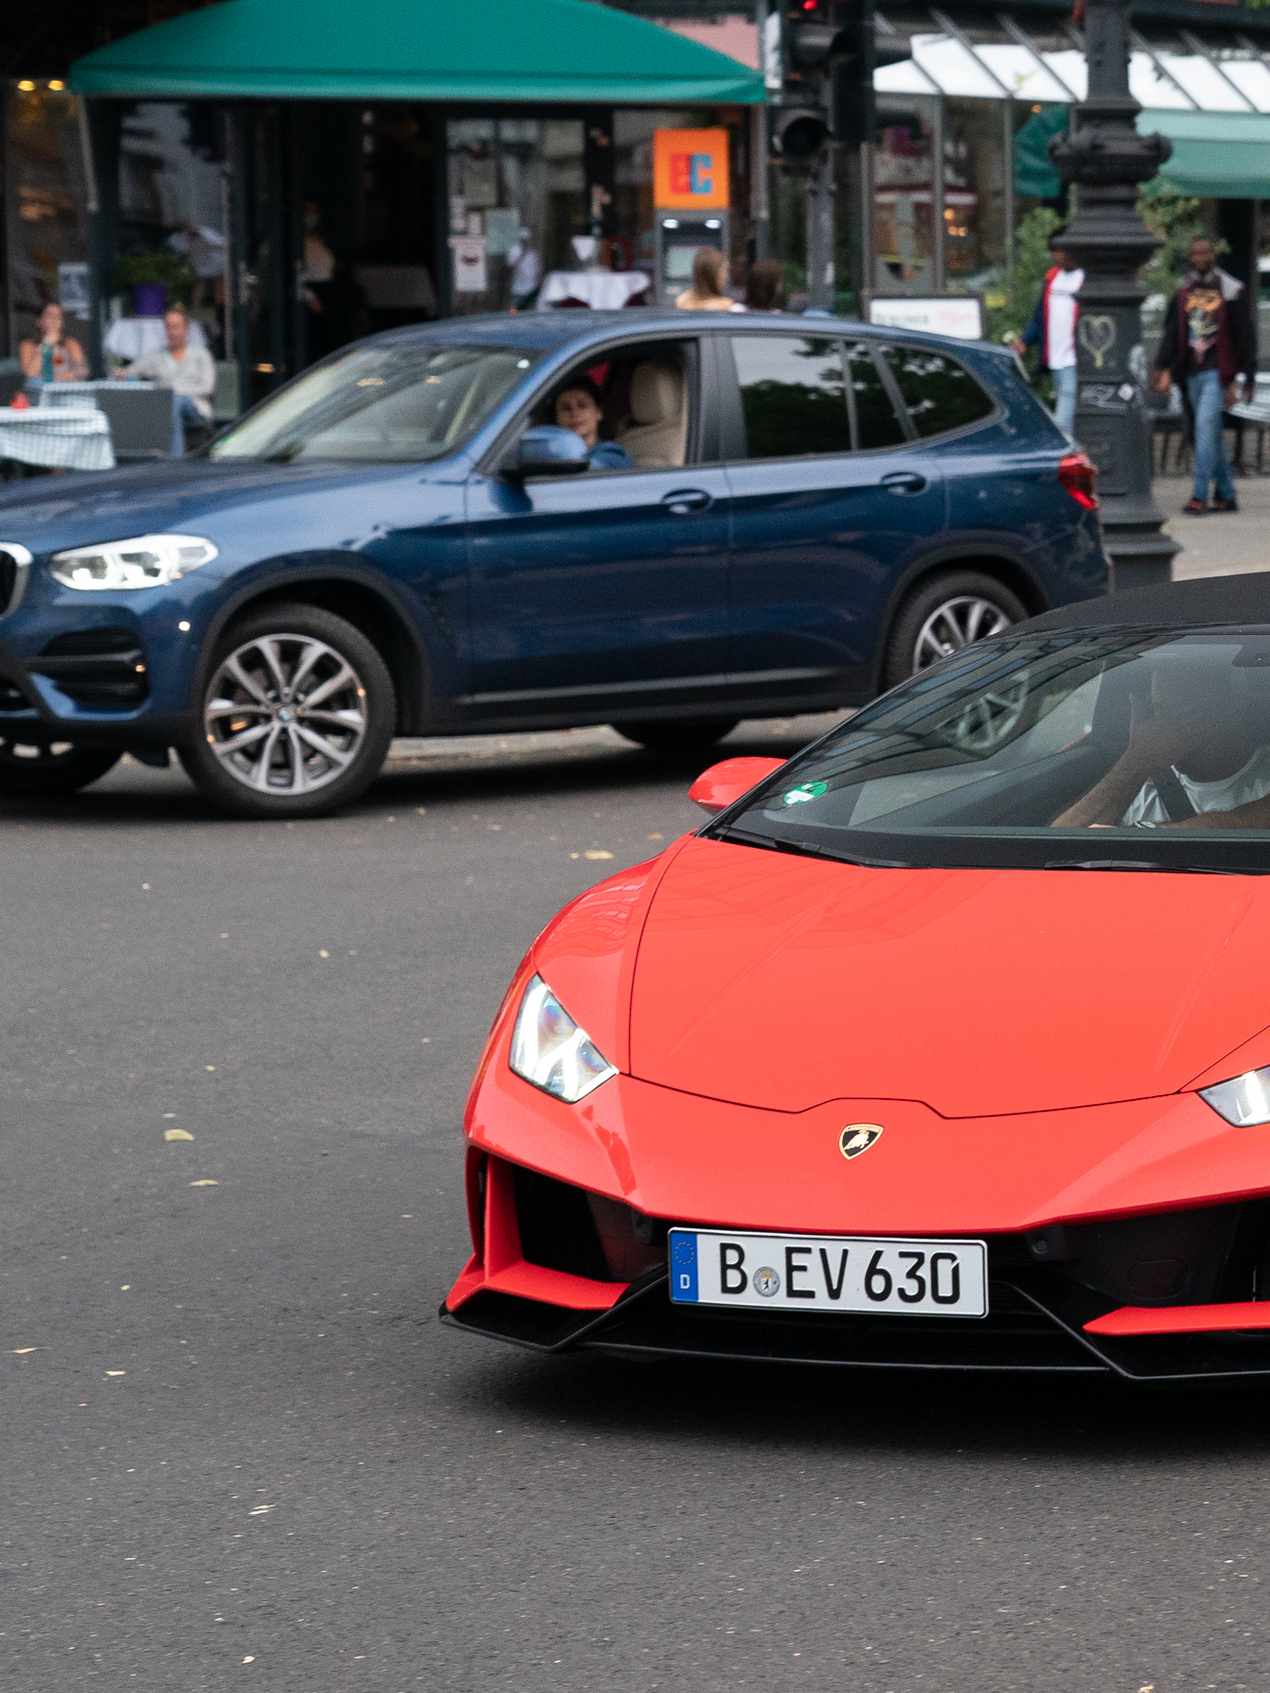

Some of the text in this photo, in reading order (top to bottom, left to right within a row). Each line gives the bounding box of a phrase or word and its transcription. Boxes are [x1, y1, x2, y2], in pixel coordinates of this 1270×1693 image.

[670, 152, 714, 194] EC
[680, 1274, 691, 1289] D
[719, 1242, 961, 1305] B EV 630
